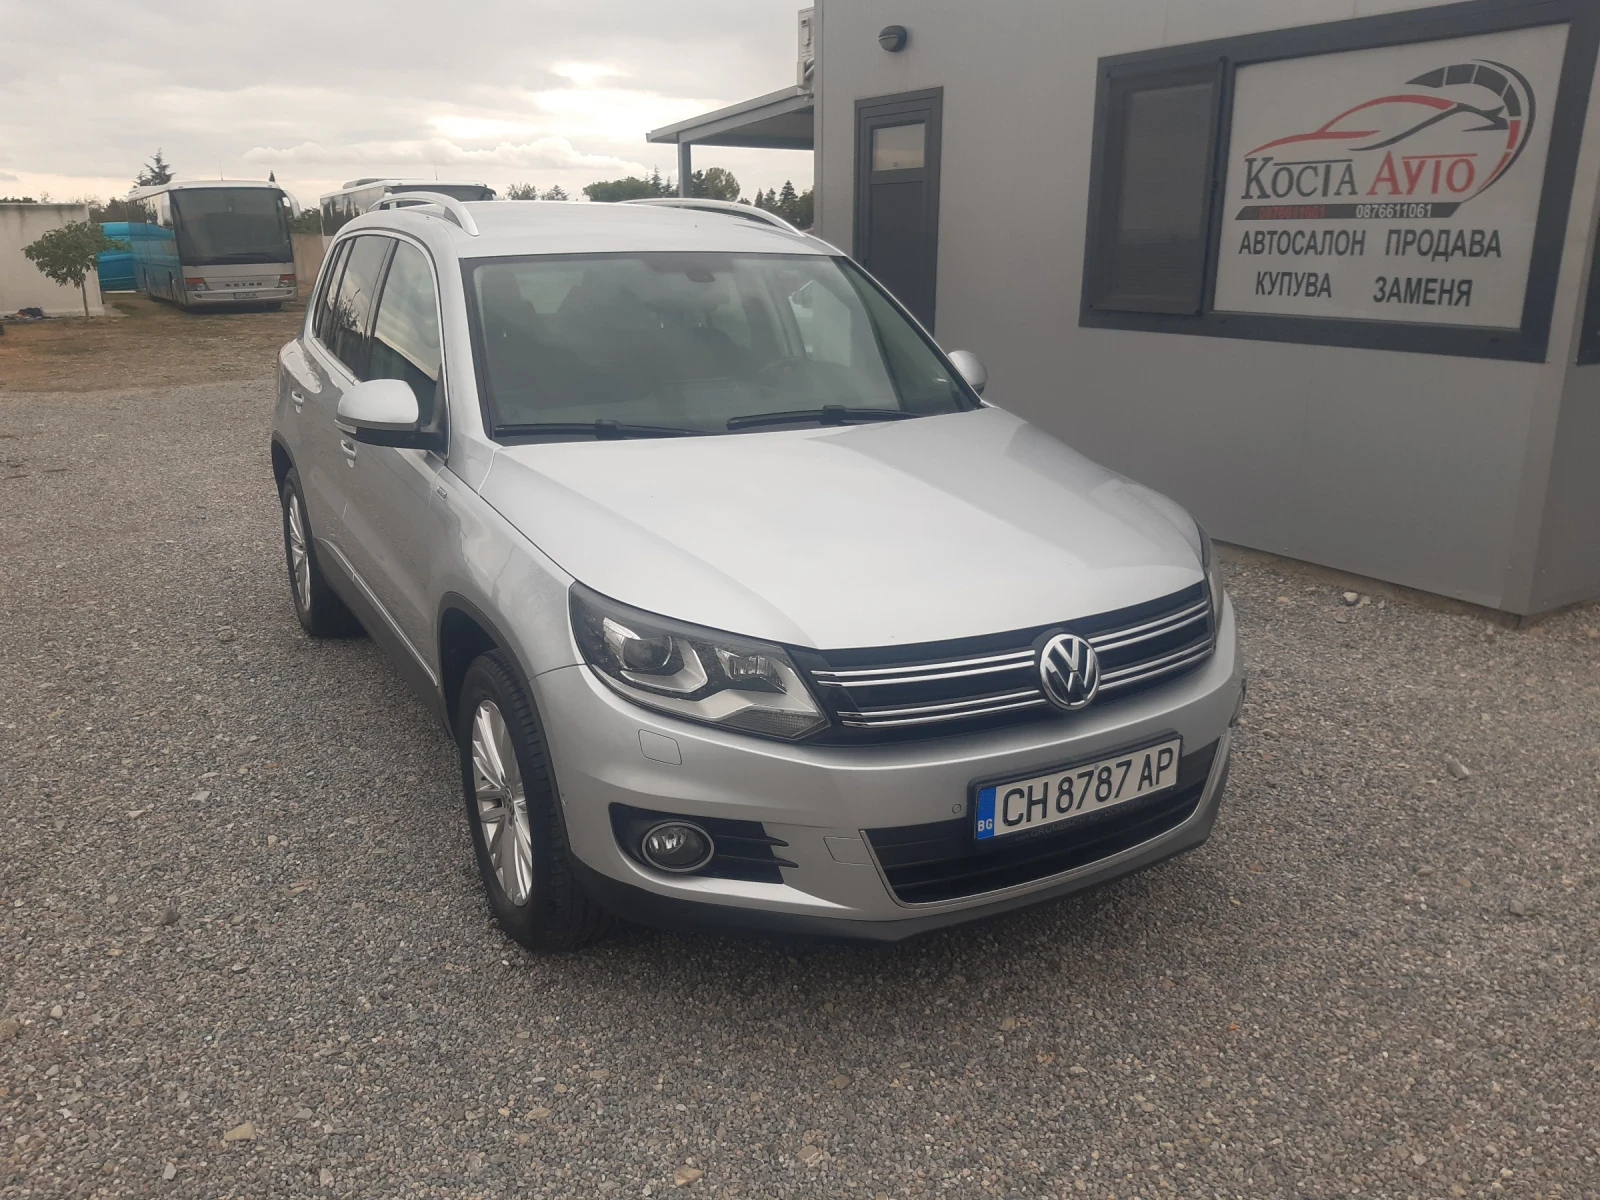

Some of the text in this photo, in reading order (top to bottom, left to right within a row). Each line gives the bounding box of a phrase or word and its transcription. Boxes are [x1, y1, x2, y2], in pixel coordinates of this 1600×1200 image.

[1355, 203, 1433, 219] 0876611061
[1238, 229, 1502, 262] АВТОСАЛОН ПРОДАВА
[1255, 271, 1473, 307] КУПУВА ЗАМЕНЯ
[977, 818, 993, 832] BG
